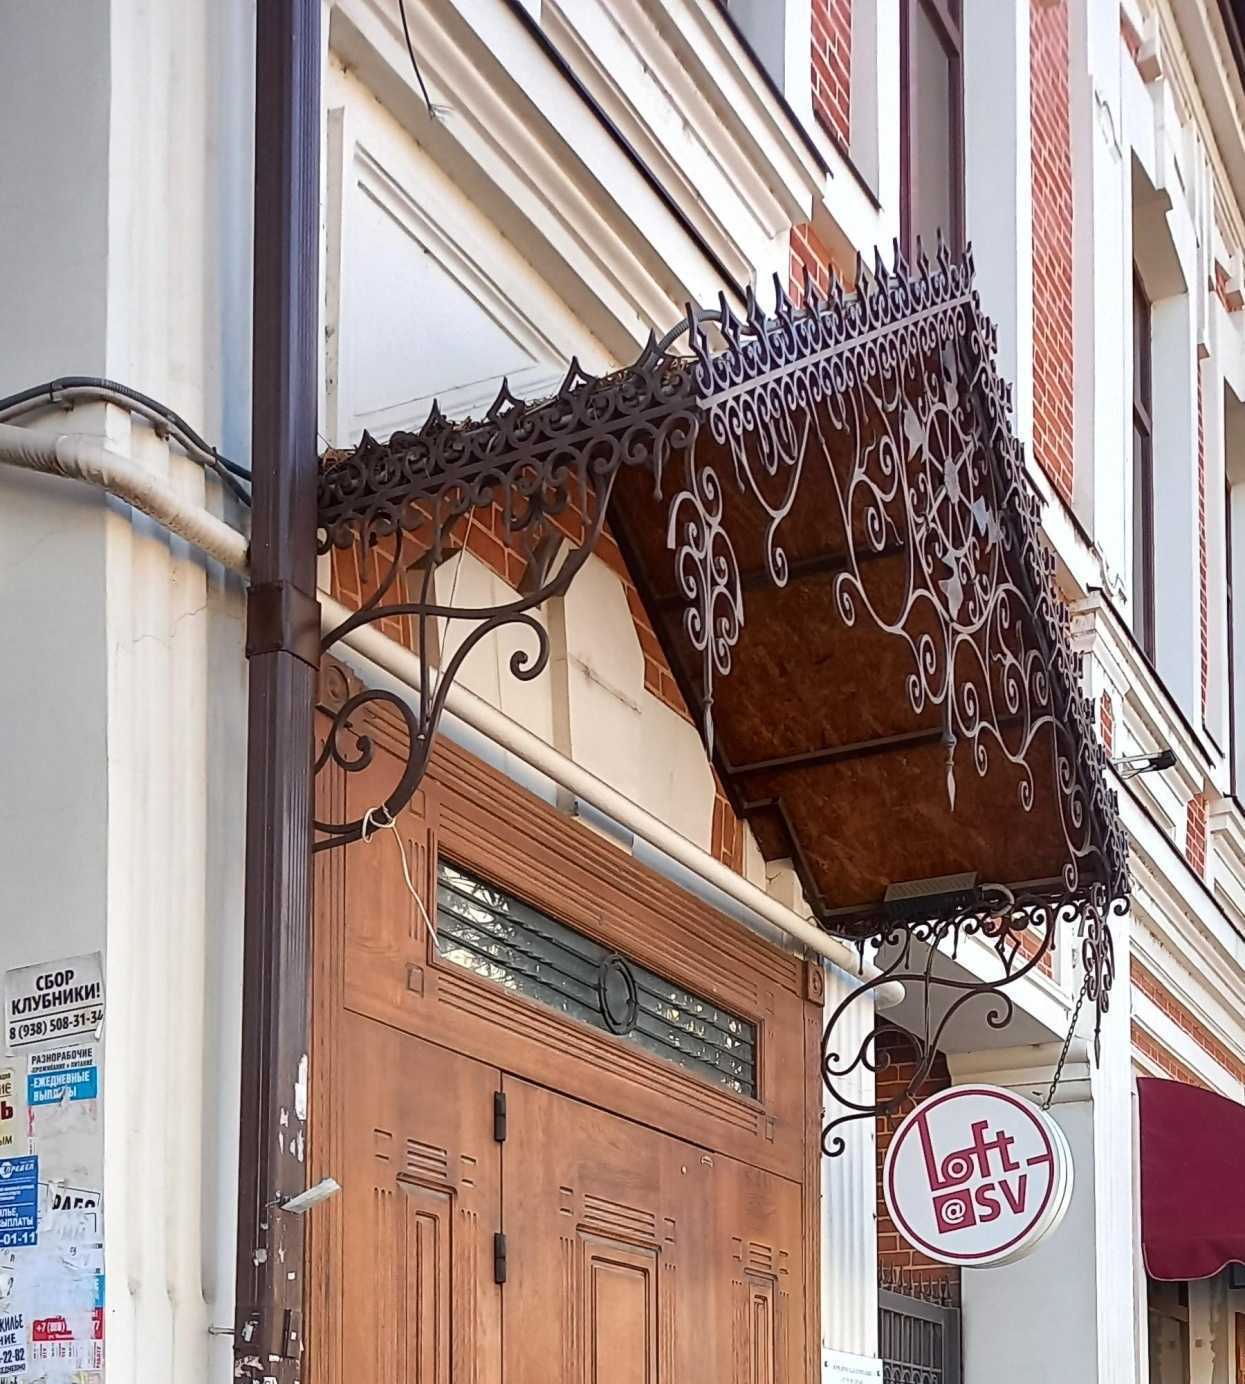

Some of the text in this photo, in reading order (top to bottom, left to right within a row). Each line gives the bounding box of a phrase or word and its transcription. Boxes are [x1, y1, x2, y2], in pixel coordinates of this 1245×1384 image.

[36, 970, 74, 991] СБОР
[12, 982, 101, 1015] КЛУБНИКИ!
[9, 1026, 16, 1040] 8
[18, 1020, 47, 1040] (938)
[31, 1048, 93, 1066] РАЗНОРАБОЧИЕ
[916, 1111, 1020, 1192] Loft
